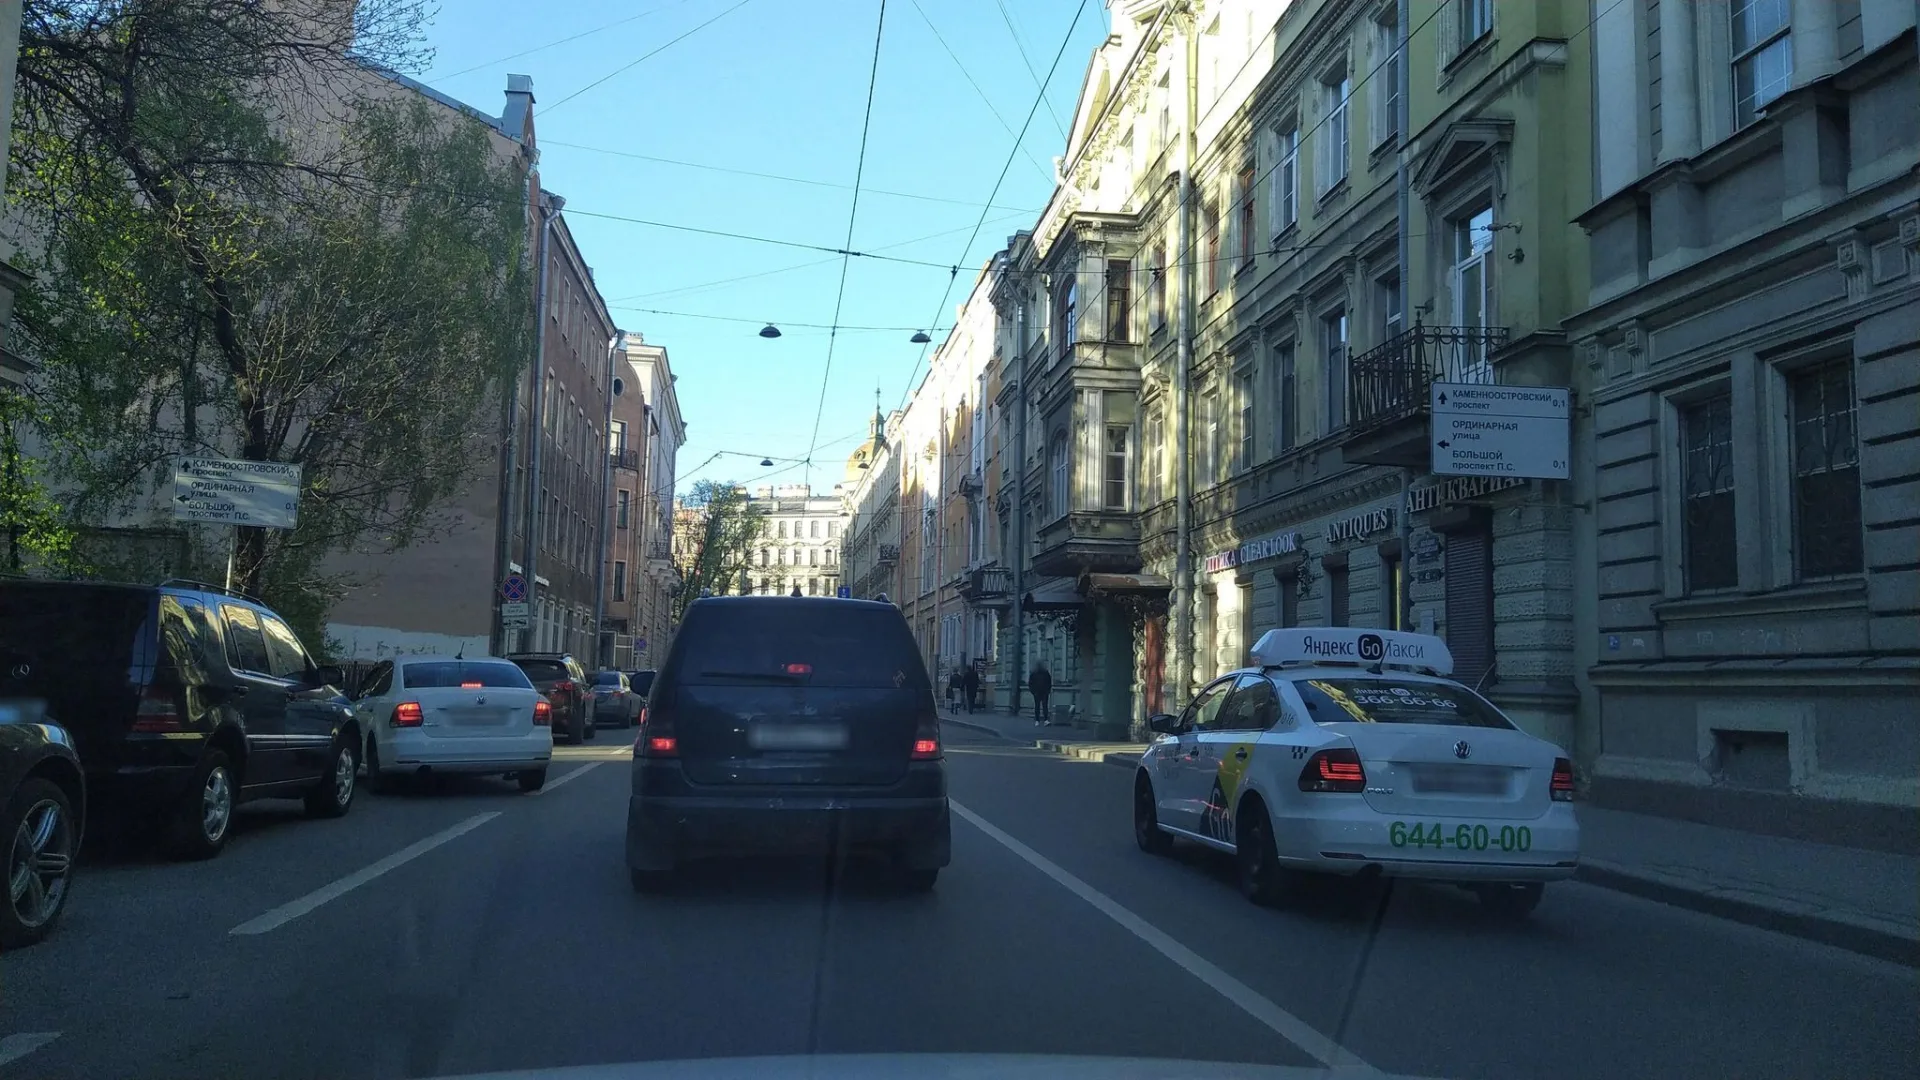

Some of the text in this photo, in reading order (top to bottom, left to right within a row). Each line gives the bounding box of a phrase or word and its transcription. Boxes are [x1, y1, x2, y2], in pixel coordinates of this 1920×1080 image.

[1452, 389, 1552, 402] КАМЕННООСТРОВСКИЙ
[1452, 402, 1490, 410] проспект
[1452, 420, 1518, 431] ОРДИНАРНАЯ
[1452, 432, 1480, 440] улица
[1452, 450, 1503, 460] БОЛЬШОЙ
[192, 468, 232, 477] проспект
[1452, 463, 1495, 471] проспект
[191, 481, 254, 494] ОРДИНАРНАЯ
[190, 490, 217, 498] улица
[188, 501, 235, 512] БОЛЬШОЙ
[188, 510, 229, 519] проспект
[1325, 508, 1388, 542] ANTIQUES
[1240, 532, 1296, 564] CLEAR LOOK
[1303, 635, 1425, 658] Яндекс Go Такси
[1354, 695, 1458, 708] 366-66-66
[1389, 821, 1532, 852] 644-60-00
